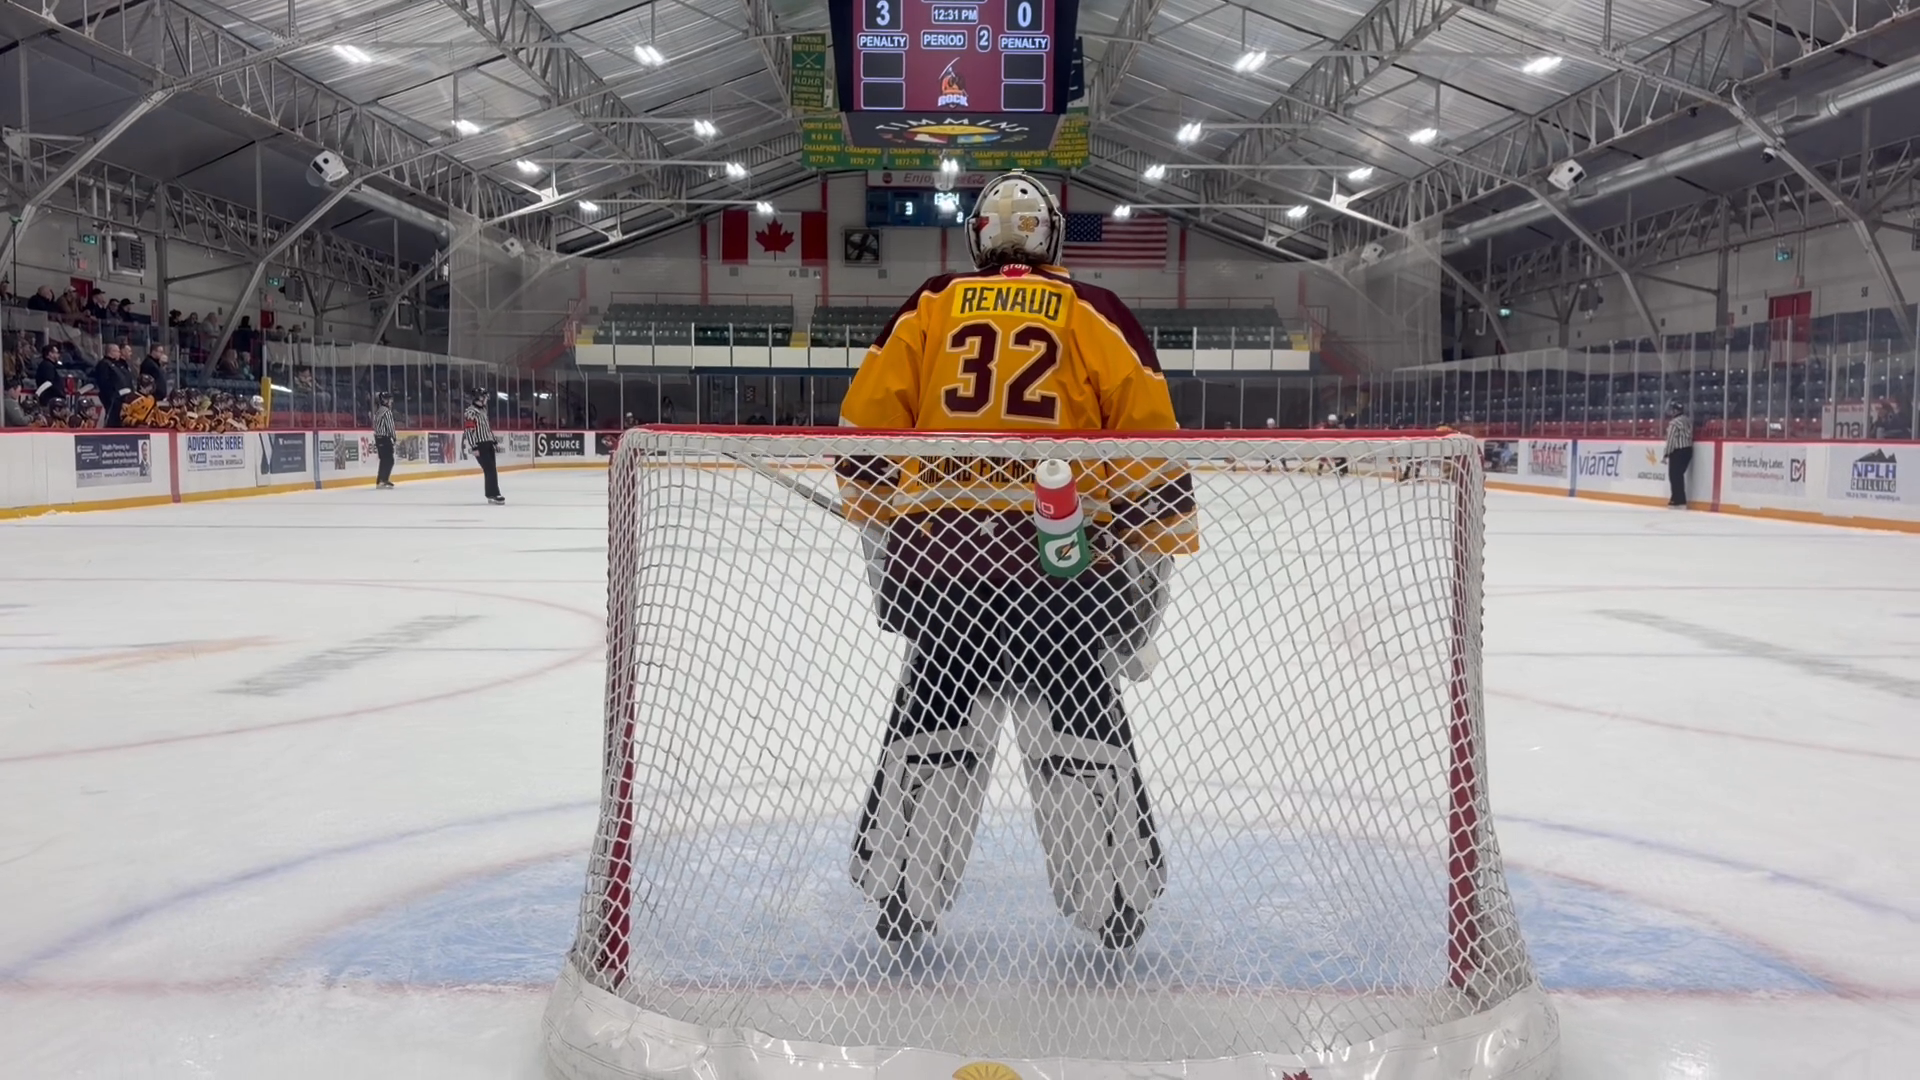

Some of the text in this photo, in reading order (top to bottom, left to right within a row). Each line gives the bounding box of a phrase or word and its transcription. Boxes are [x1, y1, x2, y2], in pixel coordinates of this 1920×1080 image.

[876, 0, 890, 26] 3
[934, 9, 978, 21] 12:31 PM
[1017, 1, 1032, 28] 0
[860, 36, 906, 47] PENALTY
[923, 30, 989, 46] PERIOD 2
[1001, 38, 1047, 49] PENALTY
[937, 94, 969, 107] ROCK
[875, 118, 1029, 132] TIMMINS
[803, 144, 841, 152] CHAMPIONS
[844, 147, 882, 155] CHAMPIONS
[1051, 151, 1089, 159] CHAMPIONS
[905, 201, 913, 216] 3
[1002, 263, 1032, 272] STOP
[960, 286, 1063, 322] RENAUD
[941, 319, 1063, 425] 32
[187, 435, 244, 451] ADVERTISE HERE!
[550, 440, 580, 449] SOURCE
[1579, 447, 1622, 477] vianet
[1852, 463, 1896, 479] NPLH
[1850, 478, 1896, 493] DRILLING
